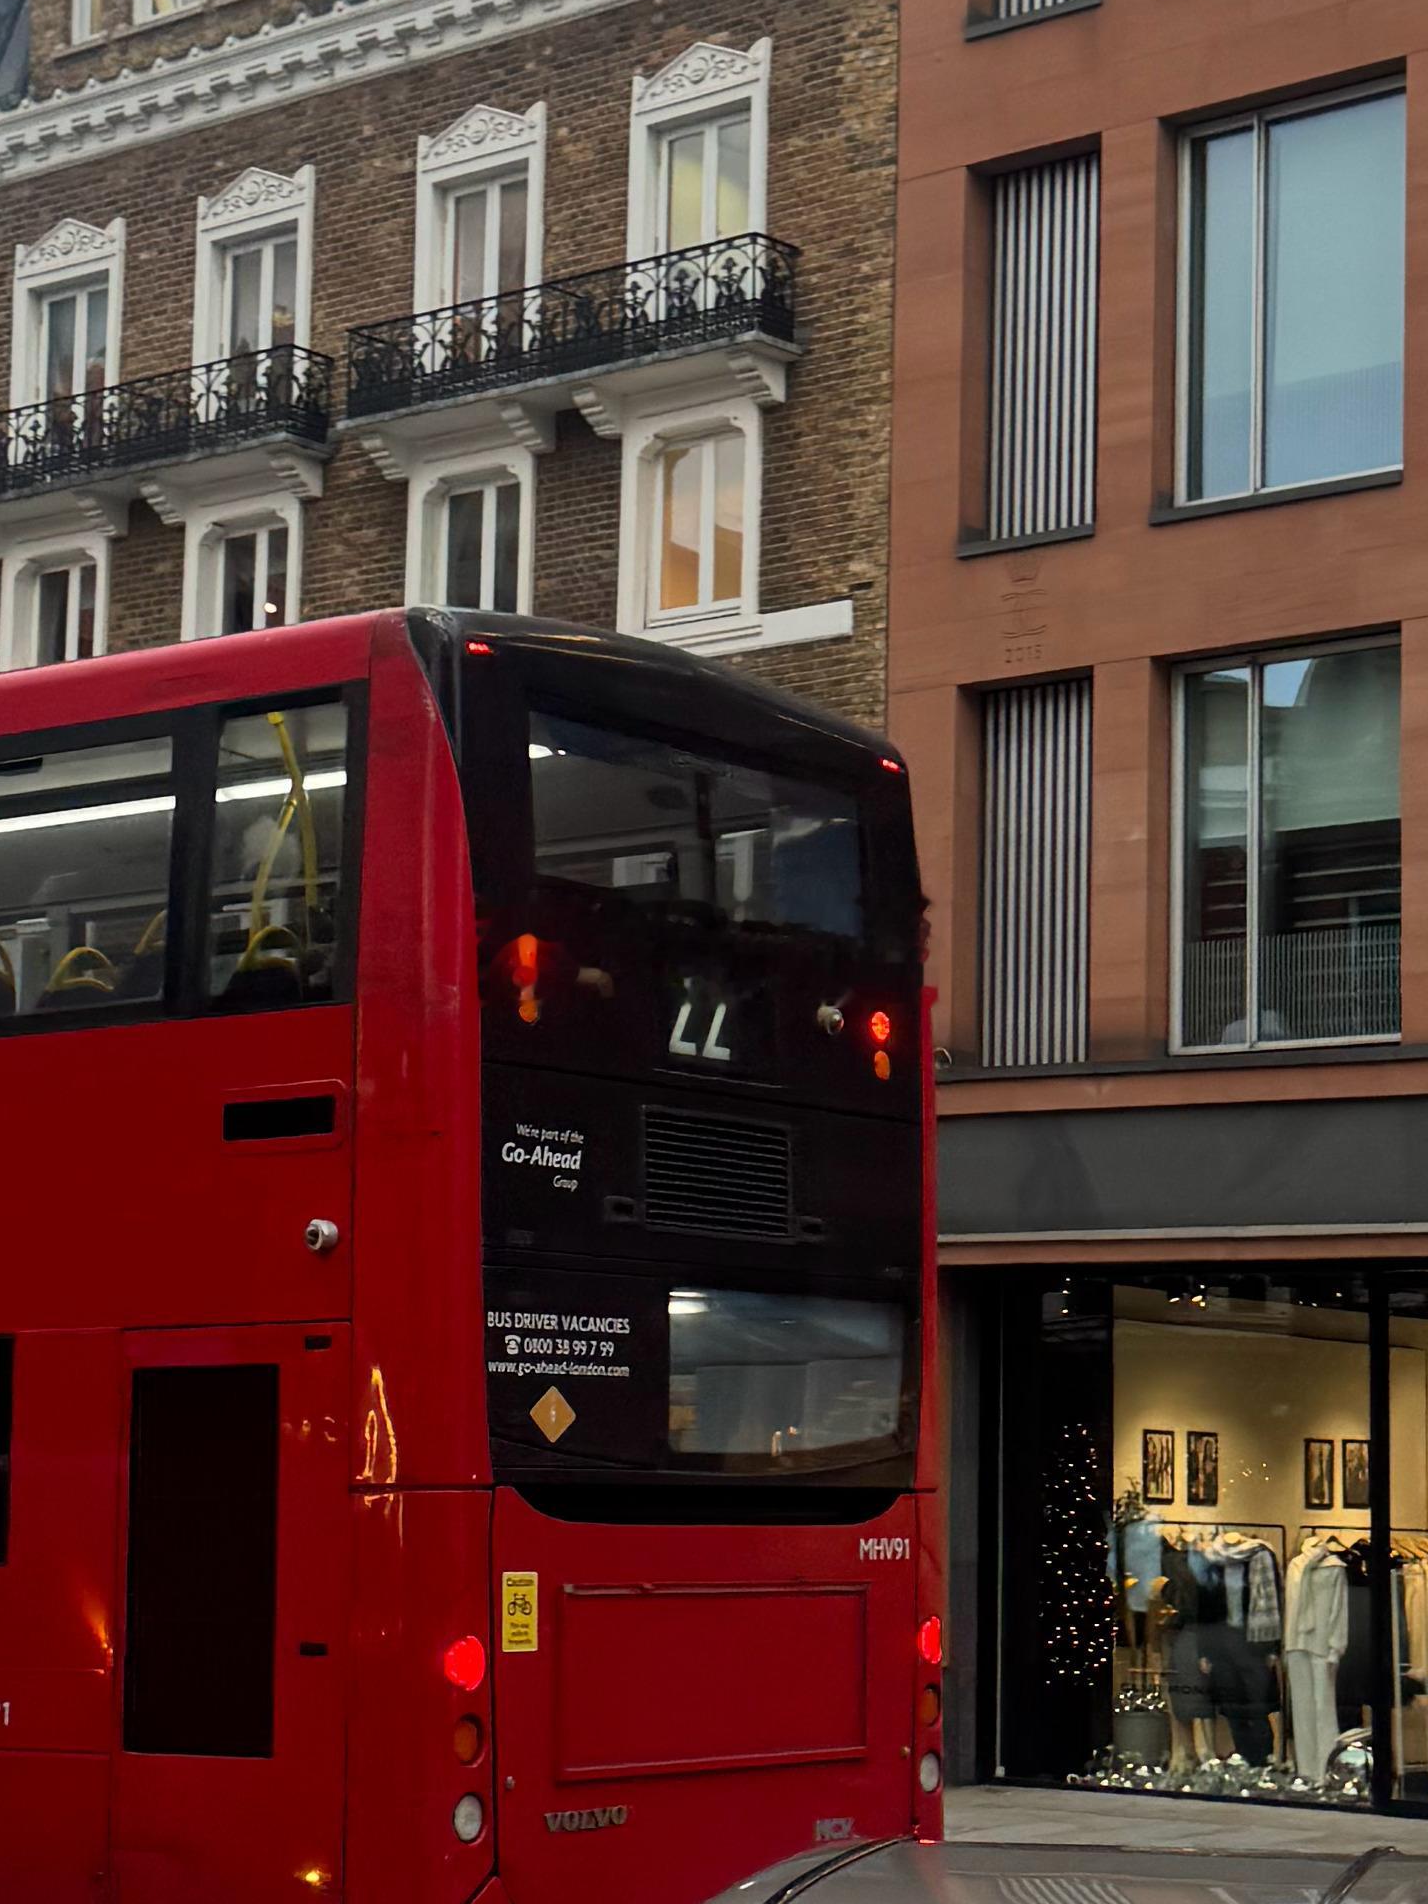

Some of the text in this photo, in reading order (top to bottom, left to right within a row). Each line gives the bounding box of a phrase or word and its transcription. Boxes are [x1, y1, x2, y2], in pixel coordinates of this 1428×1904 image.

[501, 1141, 582, 1170] Go-Ahead
[487, 1312, 630, 1334] BUS DRIVER VACANCIES
[589, 1341, 597, 1356] 7
[860, 1538, 910, 1561] MHV91
[544, 1805, 628, 1833] VOLVO
